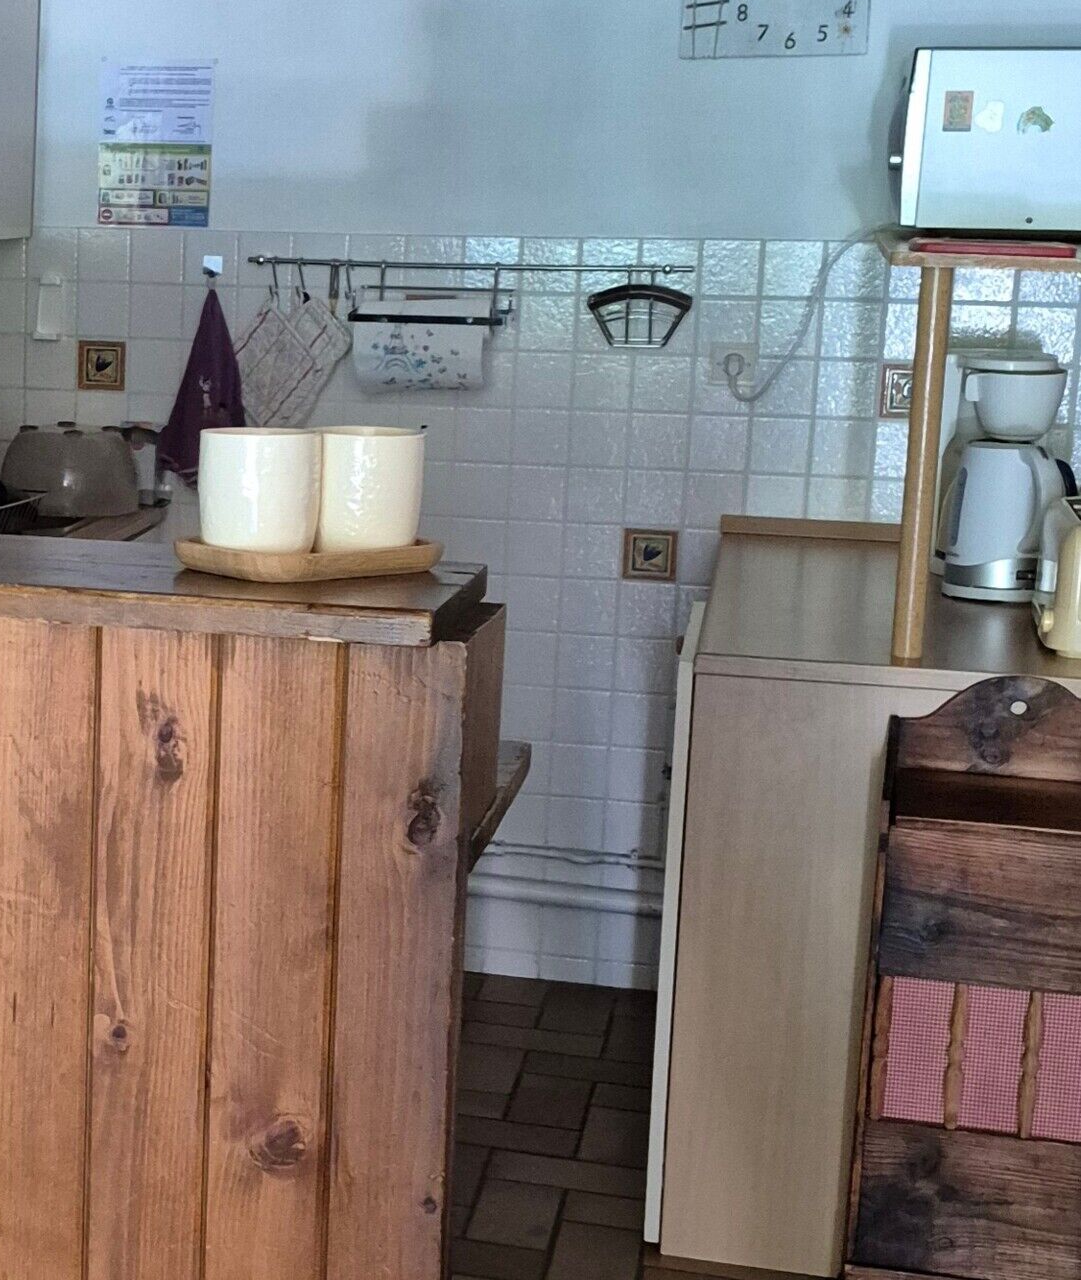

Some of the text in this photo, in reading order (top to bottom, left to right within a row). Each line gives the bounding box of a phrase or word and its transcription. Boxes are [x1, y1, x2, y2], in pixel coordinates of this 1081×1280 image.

[737, 3, 748, 21] 8
[842, 0, 855, 18] 4
[758, 24, 769, 41] 7
[784, 32, 796, 49] 6
[816, 24, 828, 42] 5
